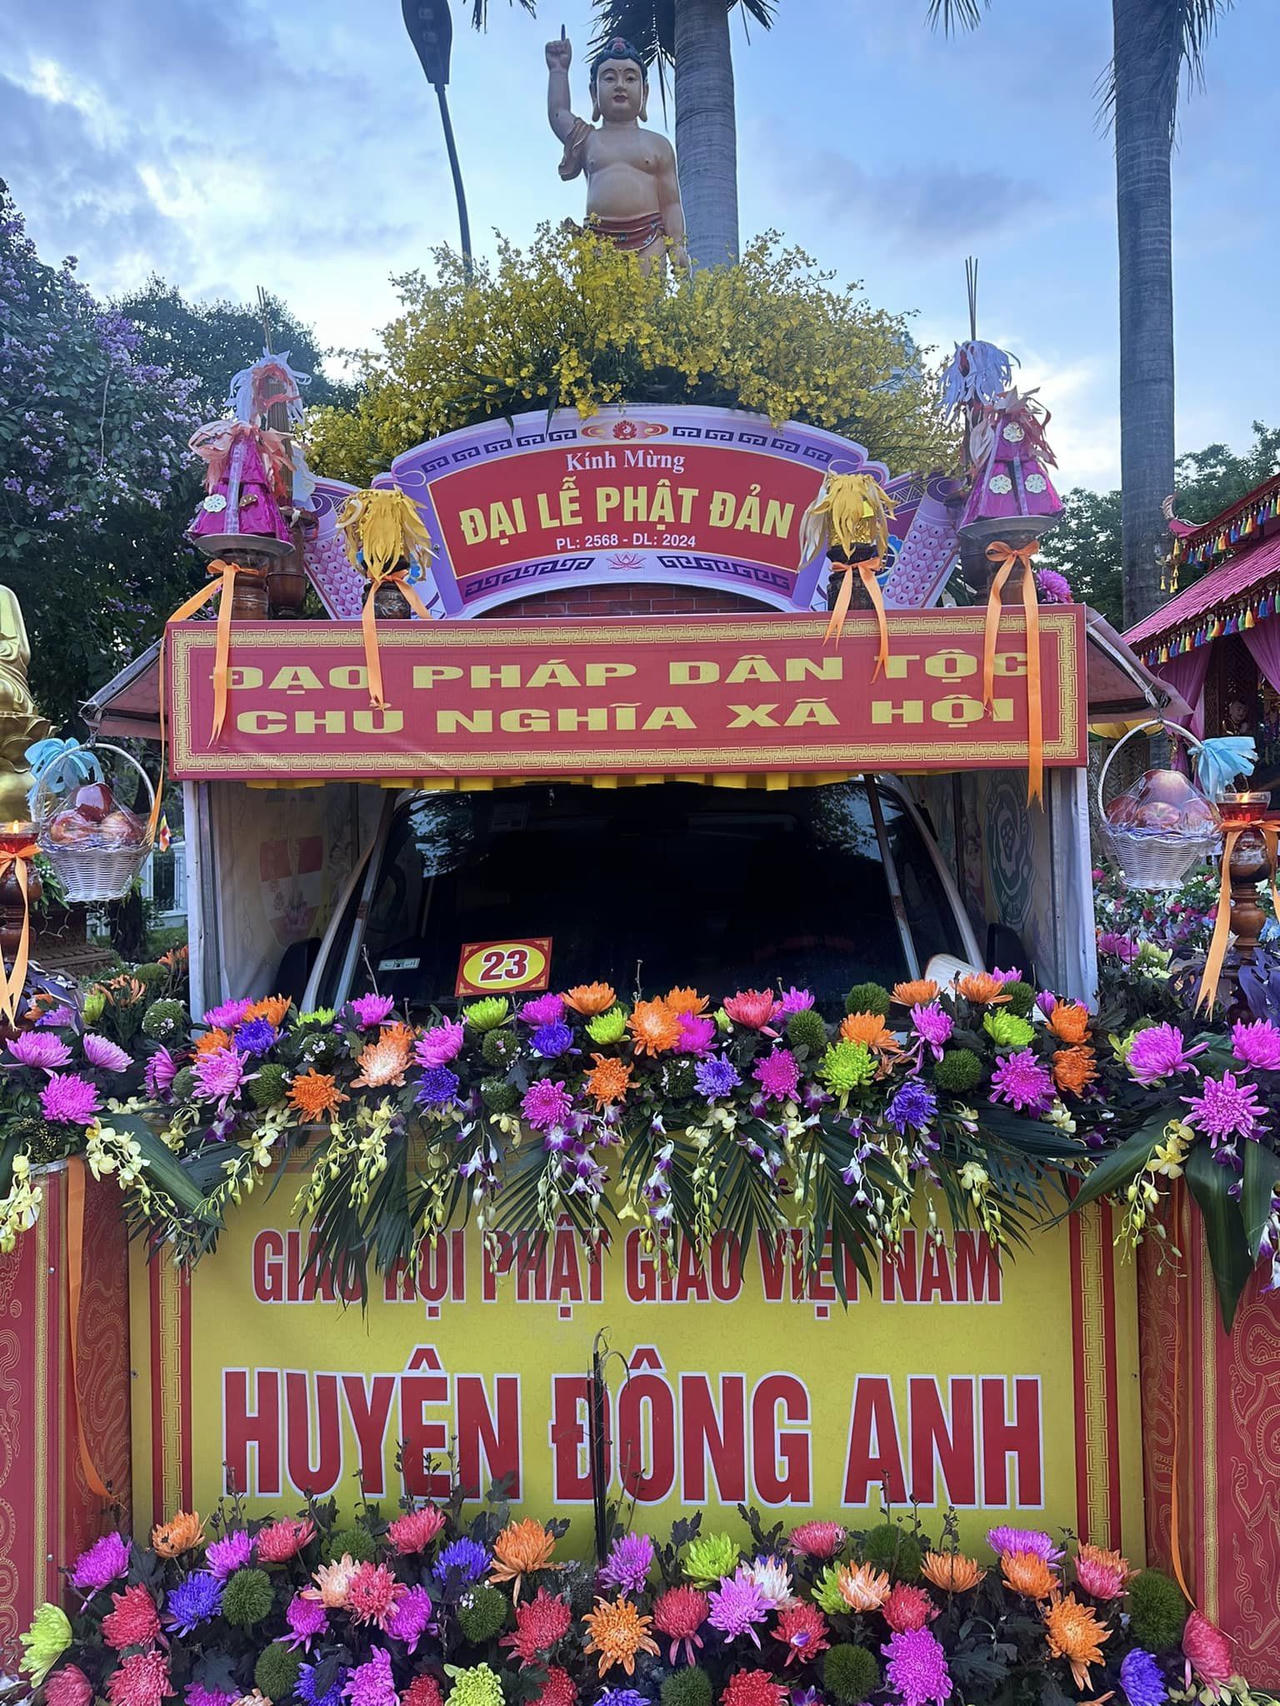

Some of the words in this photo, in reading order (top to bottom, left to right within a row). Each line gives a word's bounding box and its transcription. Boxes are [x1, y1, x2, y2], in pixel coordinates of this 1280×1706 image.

[566, 450, 618, 472] Kính
[623, 449, 685, 474] Mừng
[458, 497, 527, 545] ĐẠI
[537, 475, 584, 529] LỄ
[596, 478, 699, 531] PHẬT
[709, 483, 796, 540] ĐẢN
[556, 537, 580, 550] PL:
[585, 535, 620, 549] 2568
[633, 535, 657, 548] DL:
[661, 535, 696, 548] 2024
[209, 665, 369, 695] ĐẠO
[412, 659, 637, 689] PHÁP
[669, 654, 844, 685] DÂN
[874, 648, 1027, 683] TỘC
[437, 702, 698, 734] NGHĨA
[726, 697, 841, 728] XÃ
[871, 694, 1014, 728] HỘI
[479, 948, 529, 983] 23
[482, 1212, 611, 1321] PHẬT
[881, 1228, 1003, 1304] NAM
[550, 1344, 812, 1507] ĐÔNG
[843, 1374, 1044, 1510] ANH
